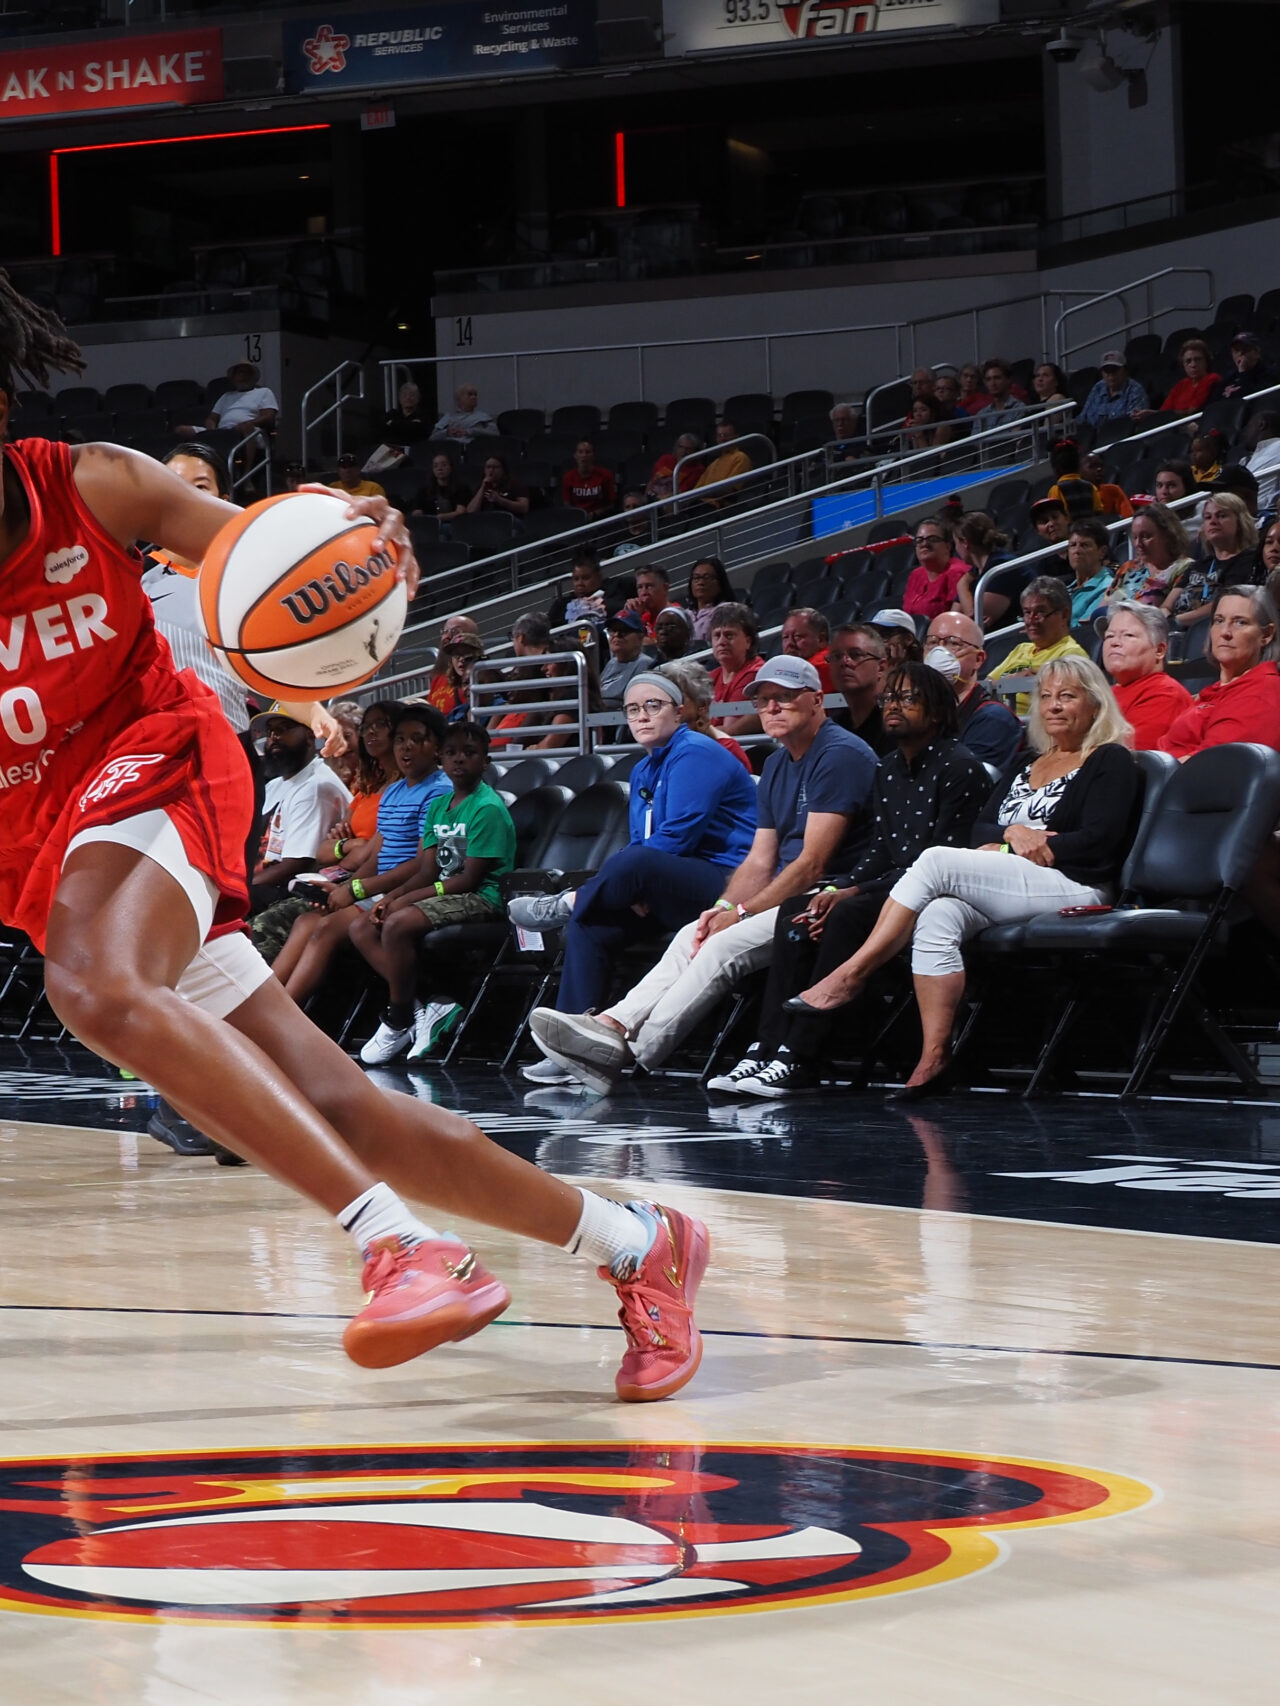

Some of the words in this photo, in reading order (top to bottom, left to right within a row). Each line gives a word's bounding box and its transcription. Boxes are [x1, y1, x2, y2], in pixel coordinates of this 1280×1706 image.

[484, 5, 568, 23] Environmental
[354, 26, 443, 48] REPUBLIC
[502, 21, 550, 35] Services
[374, 43, 424, 56] SERVICES
[474, 40, 528, 55] Recycling
[530, 39, 540, 50] &
[542, 35, 579, 49] Waste
[57, 70, 75, 91] N
[83, 50, 205, 93] SHAKE
[367, 106, 391, 126] EXIT
[455, 316, 473, 347] 14
[244, 334, 262, 363] 13
[48, 551, 86, 574] salesforce
[280, 548, 397, 624] Wilson
[0, 686, 48, 746] 0
